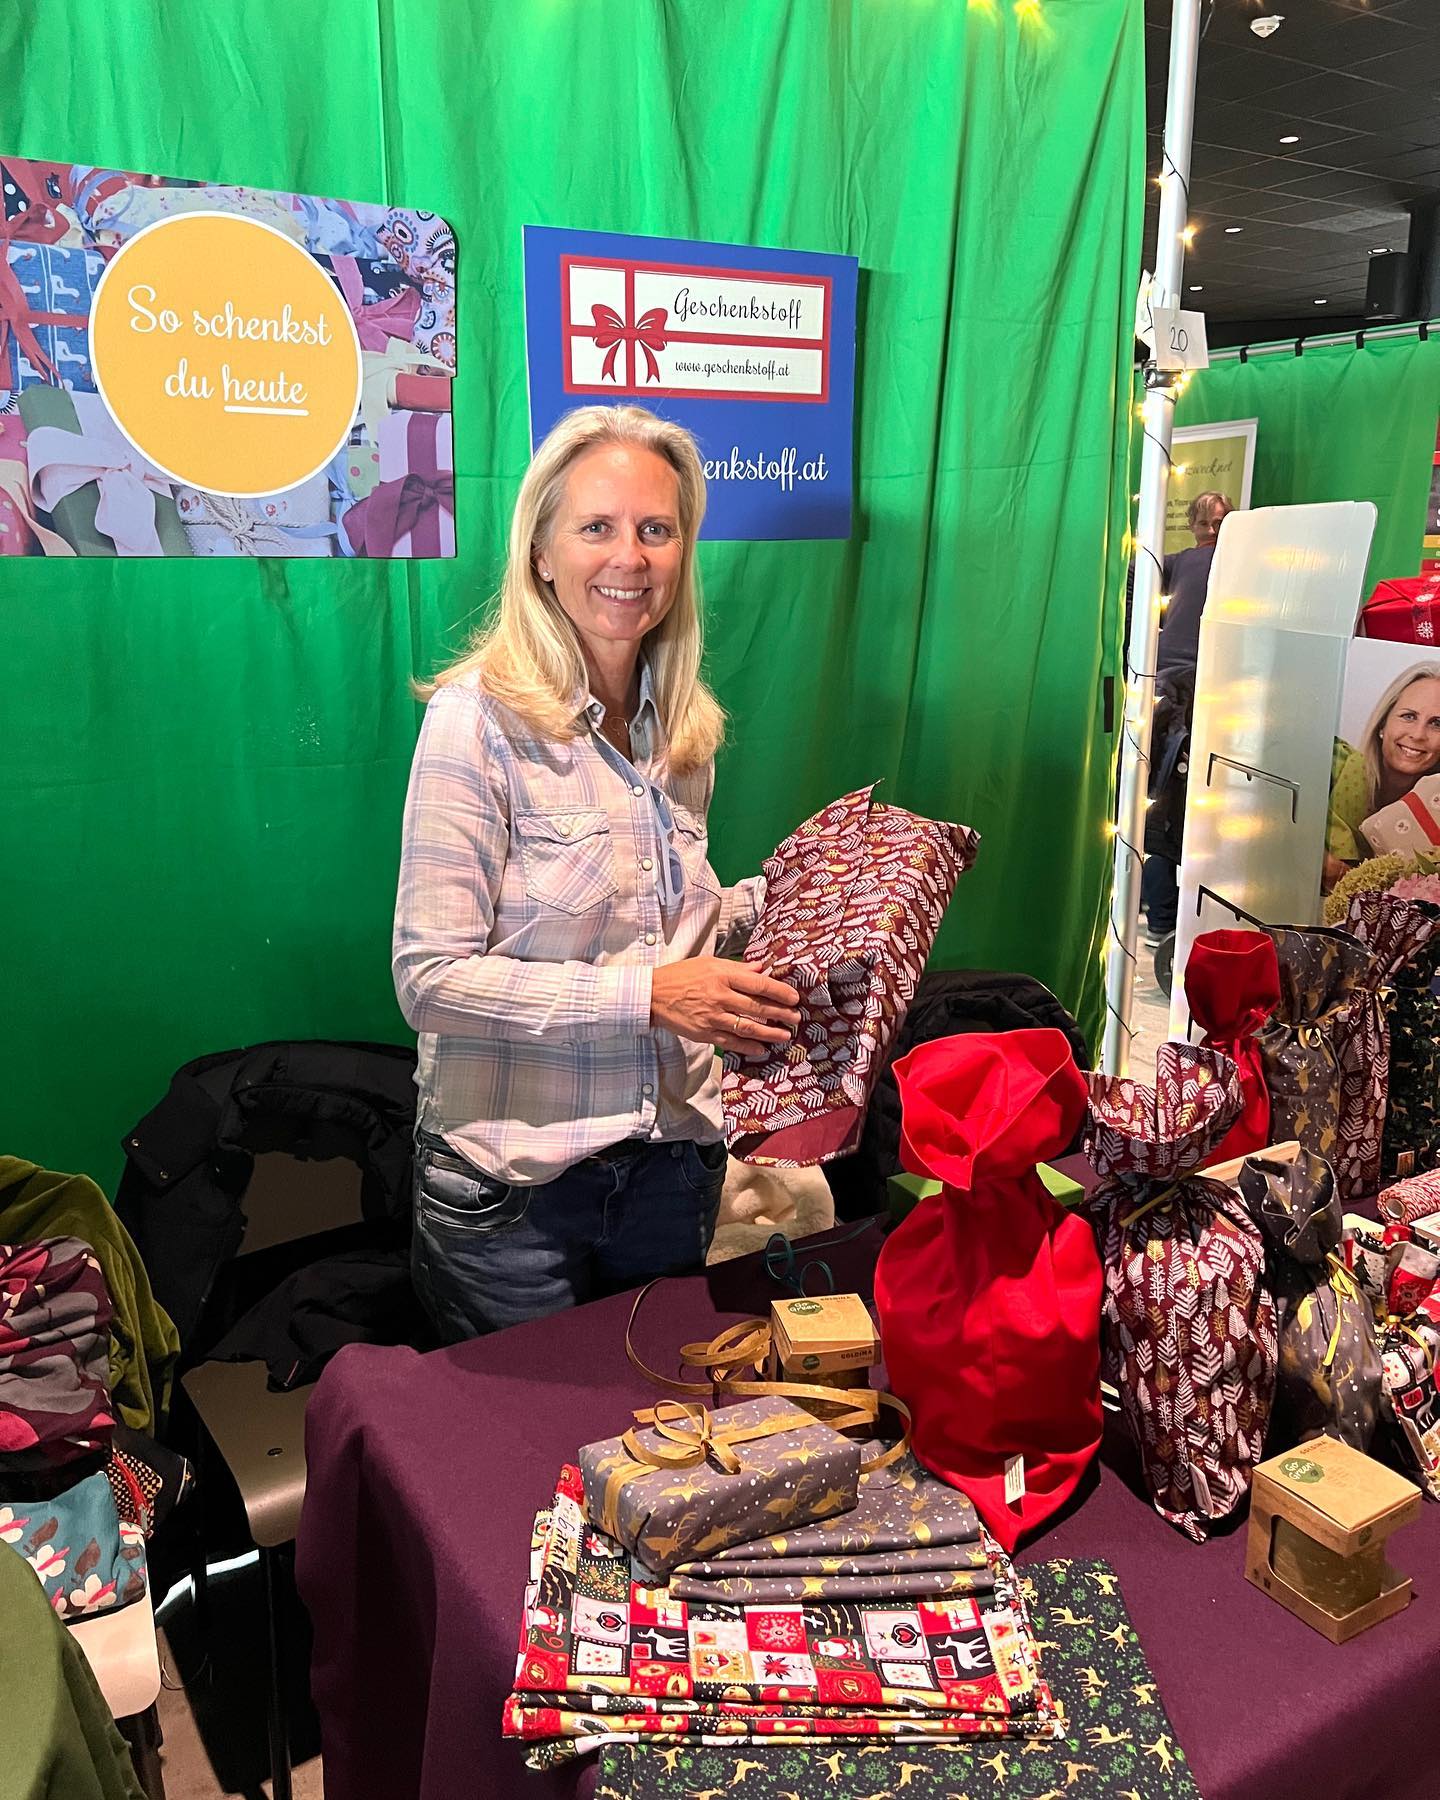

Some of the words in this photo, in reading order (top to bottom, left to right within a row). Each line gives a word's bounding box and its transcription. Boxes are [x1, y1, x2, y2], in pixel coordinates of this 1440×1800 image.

[128, 284, 183, 333] So
[193, 301, 332, 346] schenkst
[673, 287, 802, 330] Geschenkstoff
[1170, 326, 1189, 352] 20
[164, 358, 216, 400] du
[221, 364, 308, 405] heute
[675, 359, 791, 381] www.geschenkstoff.at
[703, 446, 829, 492] enkstoff.at
